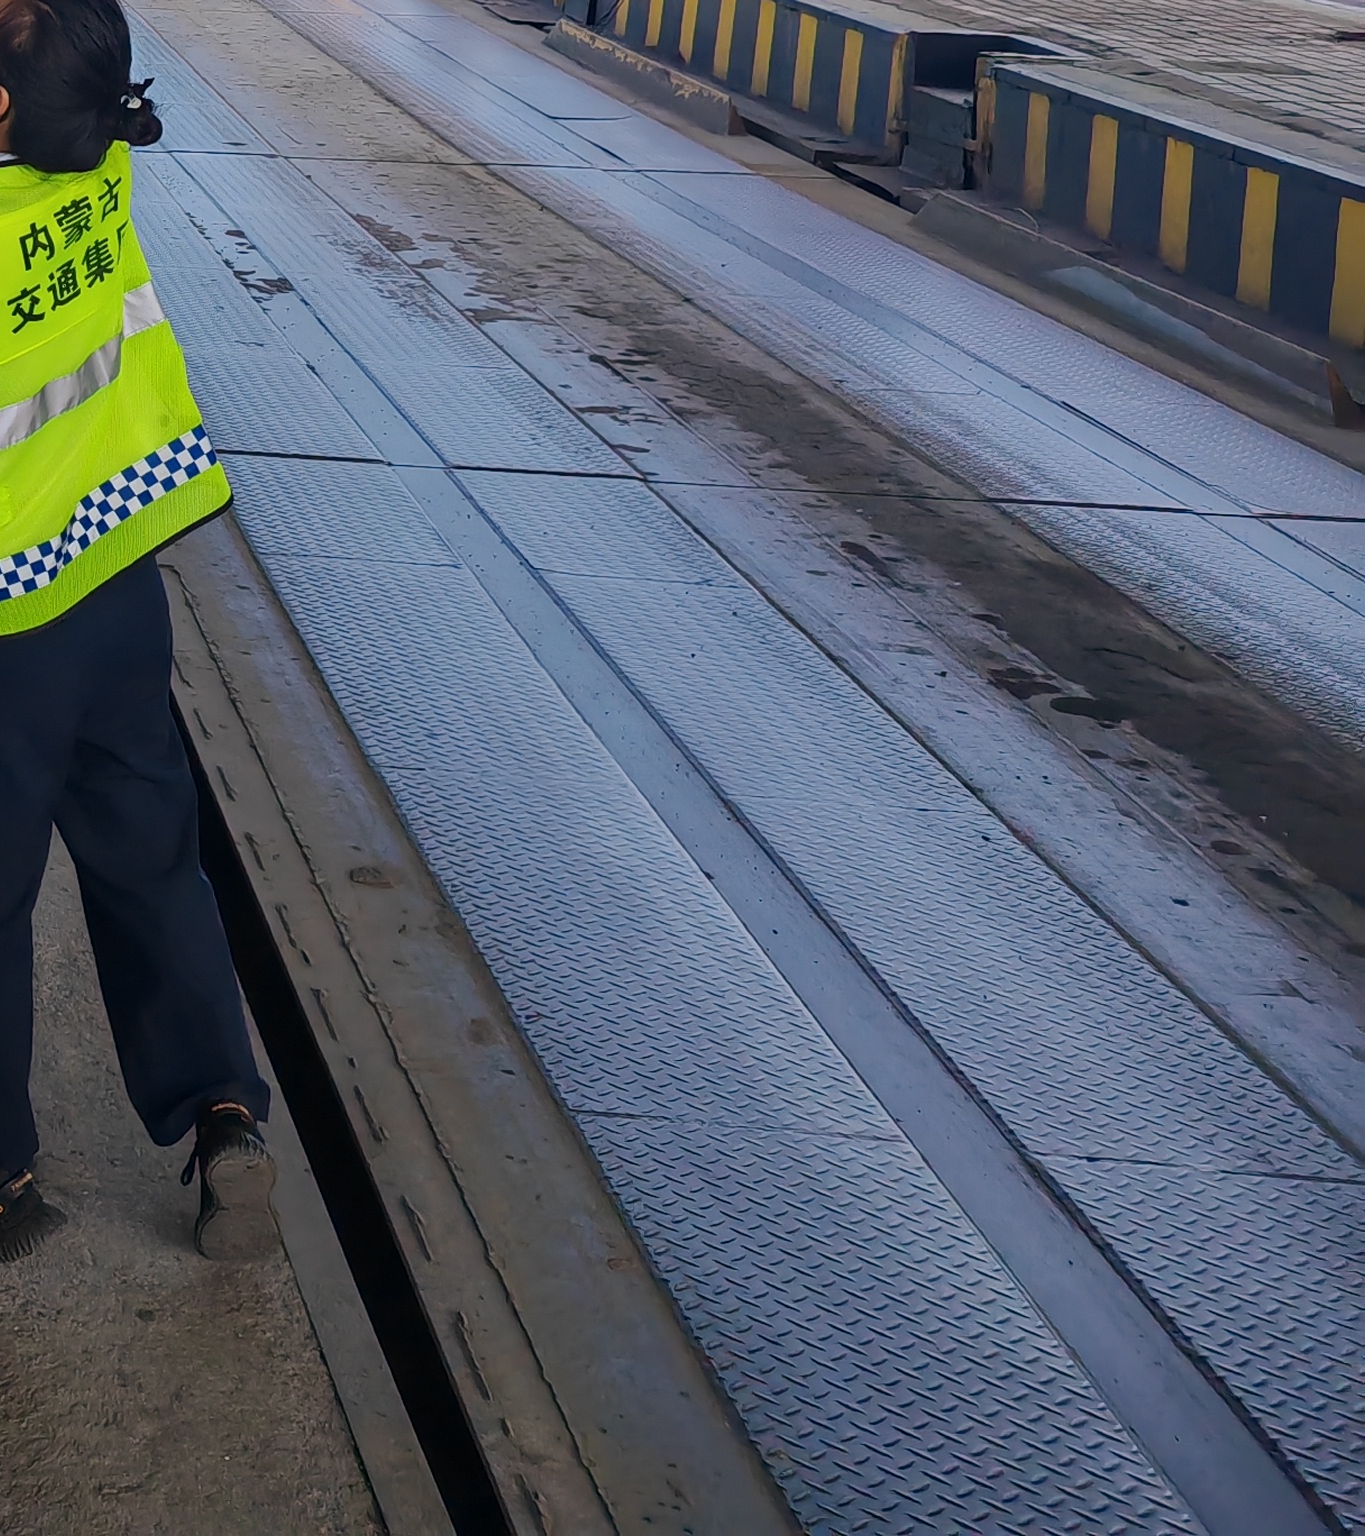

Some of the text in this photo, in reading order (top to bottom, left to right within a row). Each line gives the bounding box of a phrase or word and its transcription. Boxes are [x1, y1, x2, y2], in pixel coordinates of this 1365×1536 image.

[7, 219, 129, 334] 交通集
[18, 176, 122, 272] 内蒙古
